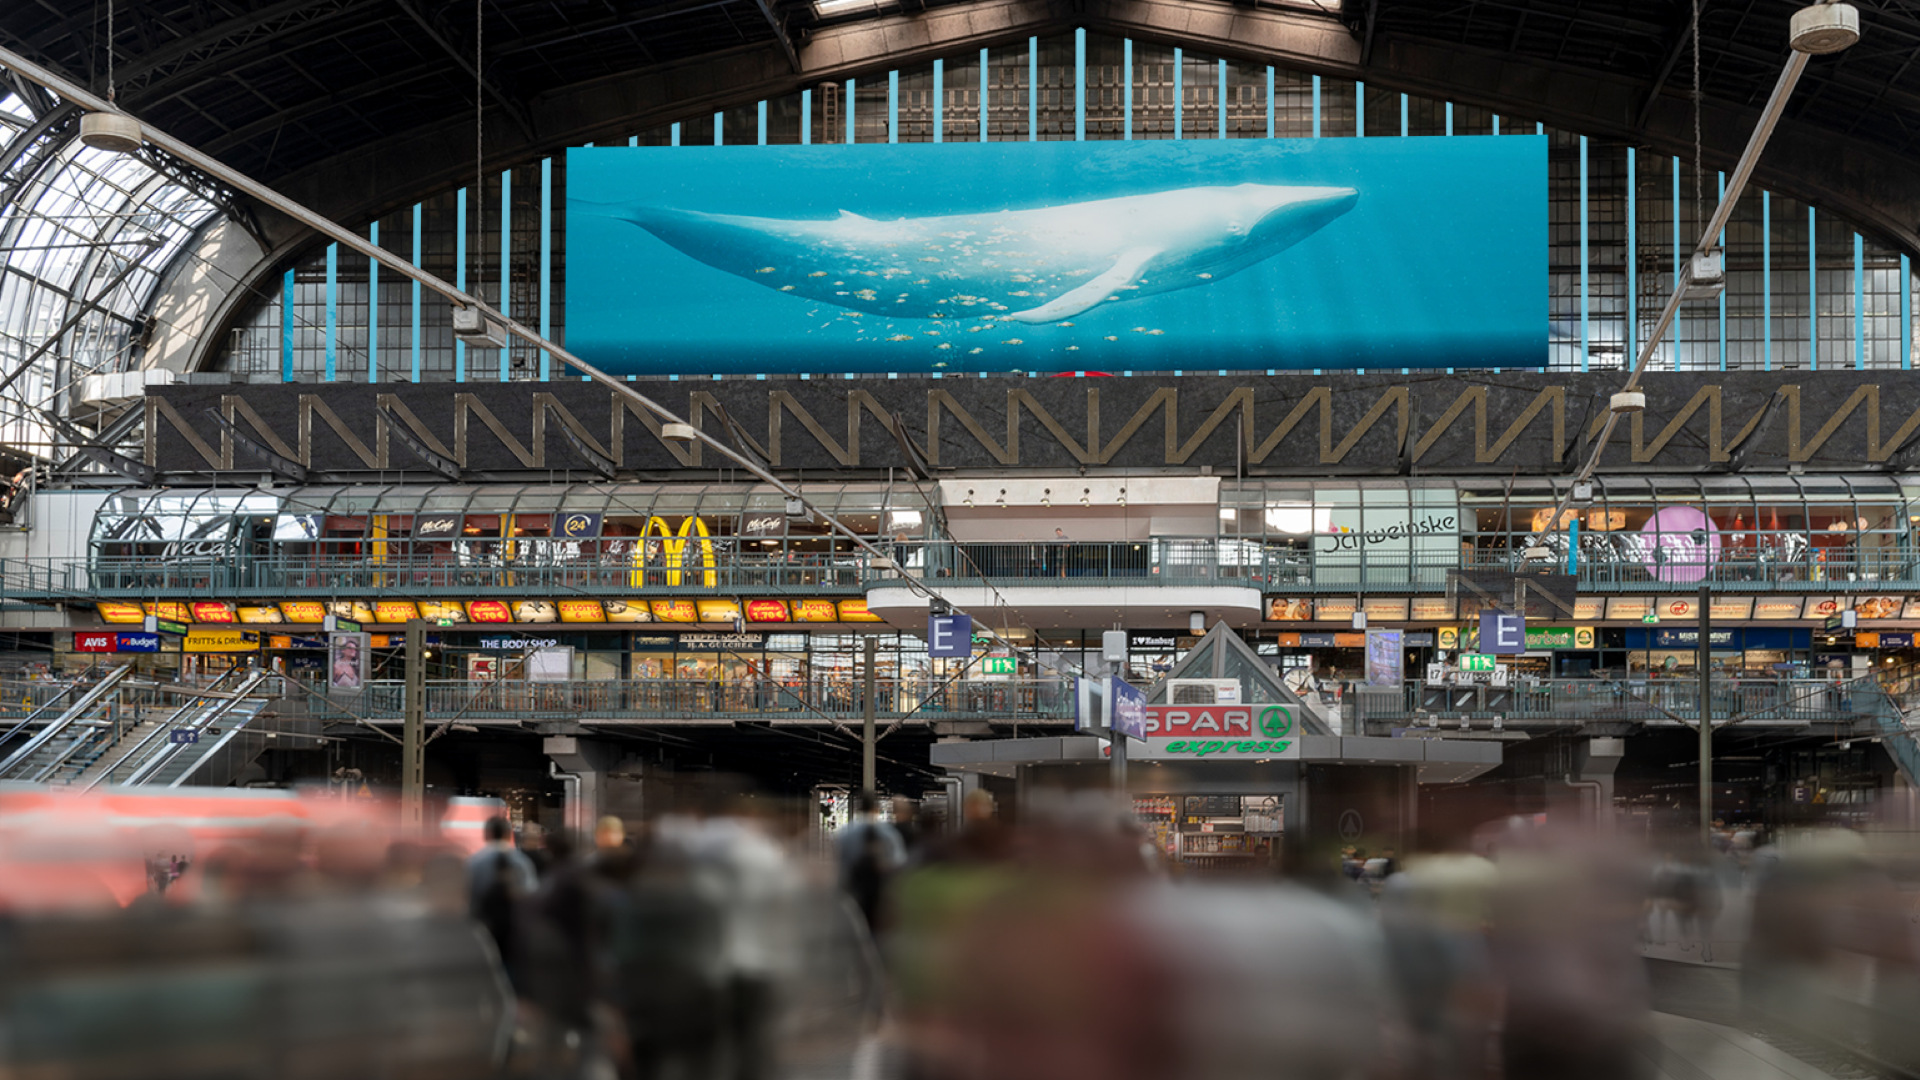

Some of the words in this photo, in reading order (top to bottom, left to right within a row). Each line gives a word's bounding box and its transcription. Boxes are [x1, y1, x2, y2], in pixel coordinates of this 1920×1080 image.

[569, 520, 586, 531] 24
[805, 603, 832, 611] LOTTO
[475, 612, 496, 621] 1,70
[753, 612, 774, 620] 1,70
[934, 619, 954, 650] E
[1497, 615, 1518, 646] E
[84, 638, 107, 647] AVIS
[130, 638, 157, 648] Budget
[480, 640, 499, 649] THE
[502, 640, 529, 649] BODY
[530, 639, 557, 648] SHOP
[1145, 637, 1175, 646] Hamburg
[1146, 710, 1250, 732] SPAR
[1165, 739, 1292, 757] express
[1794, 787, 1804, 801] E
